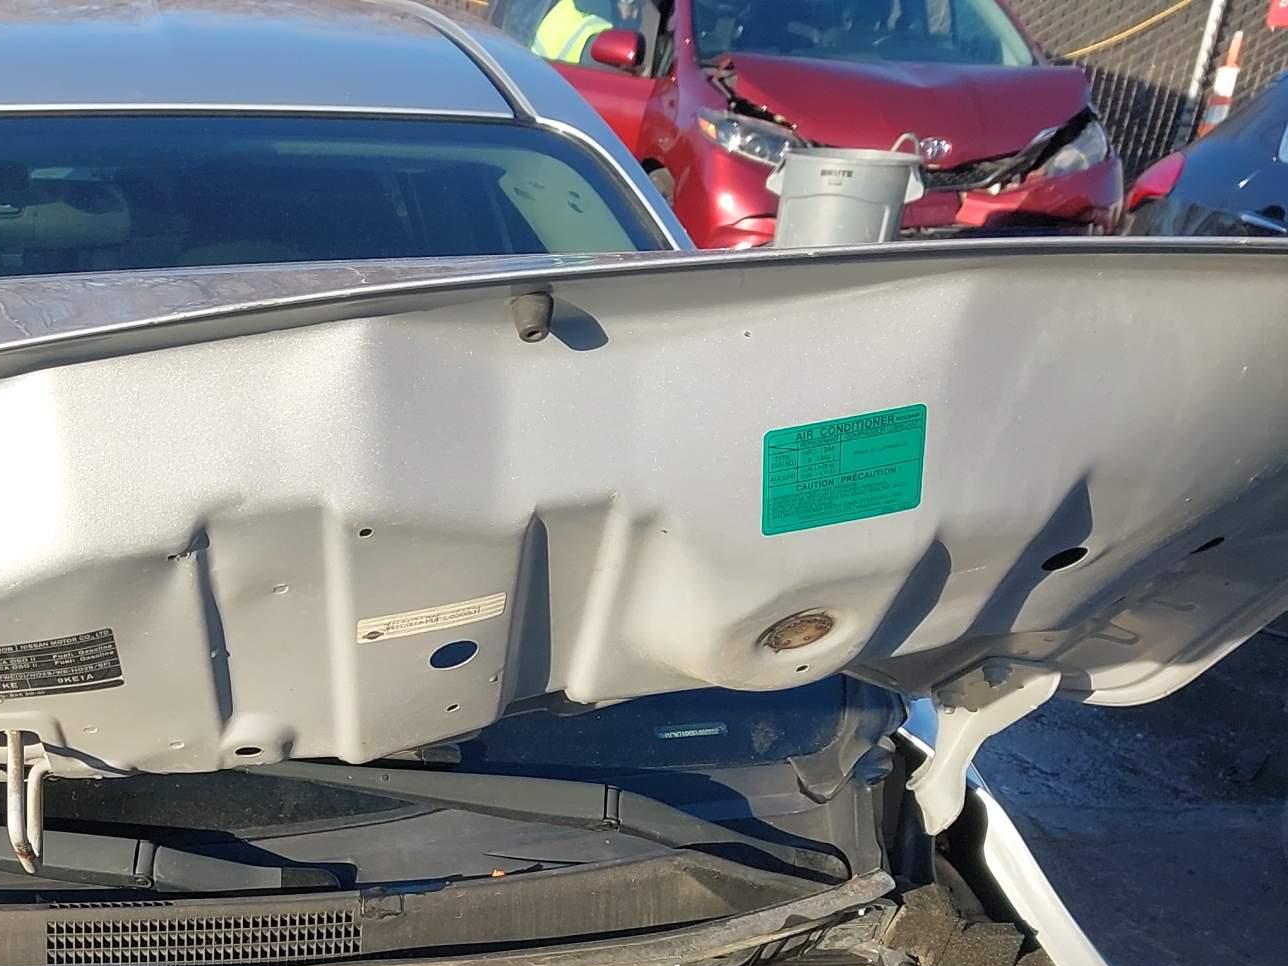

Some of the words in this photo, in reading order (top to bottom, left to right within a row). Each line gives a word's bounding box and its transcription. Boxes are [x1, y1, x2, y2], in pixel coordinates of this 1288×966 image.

[795, 431, 813, 442] AIR
[819, 415, 895, 436] CONDITIONER
[795, 479, 835, 492] CAUTION
